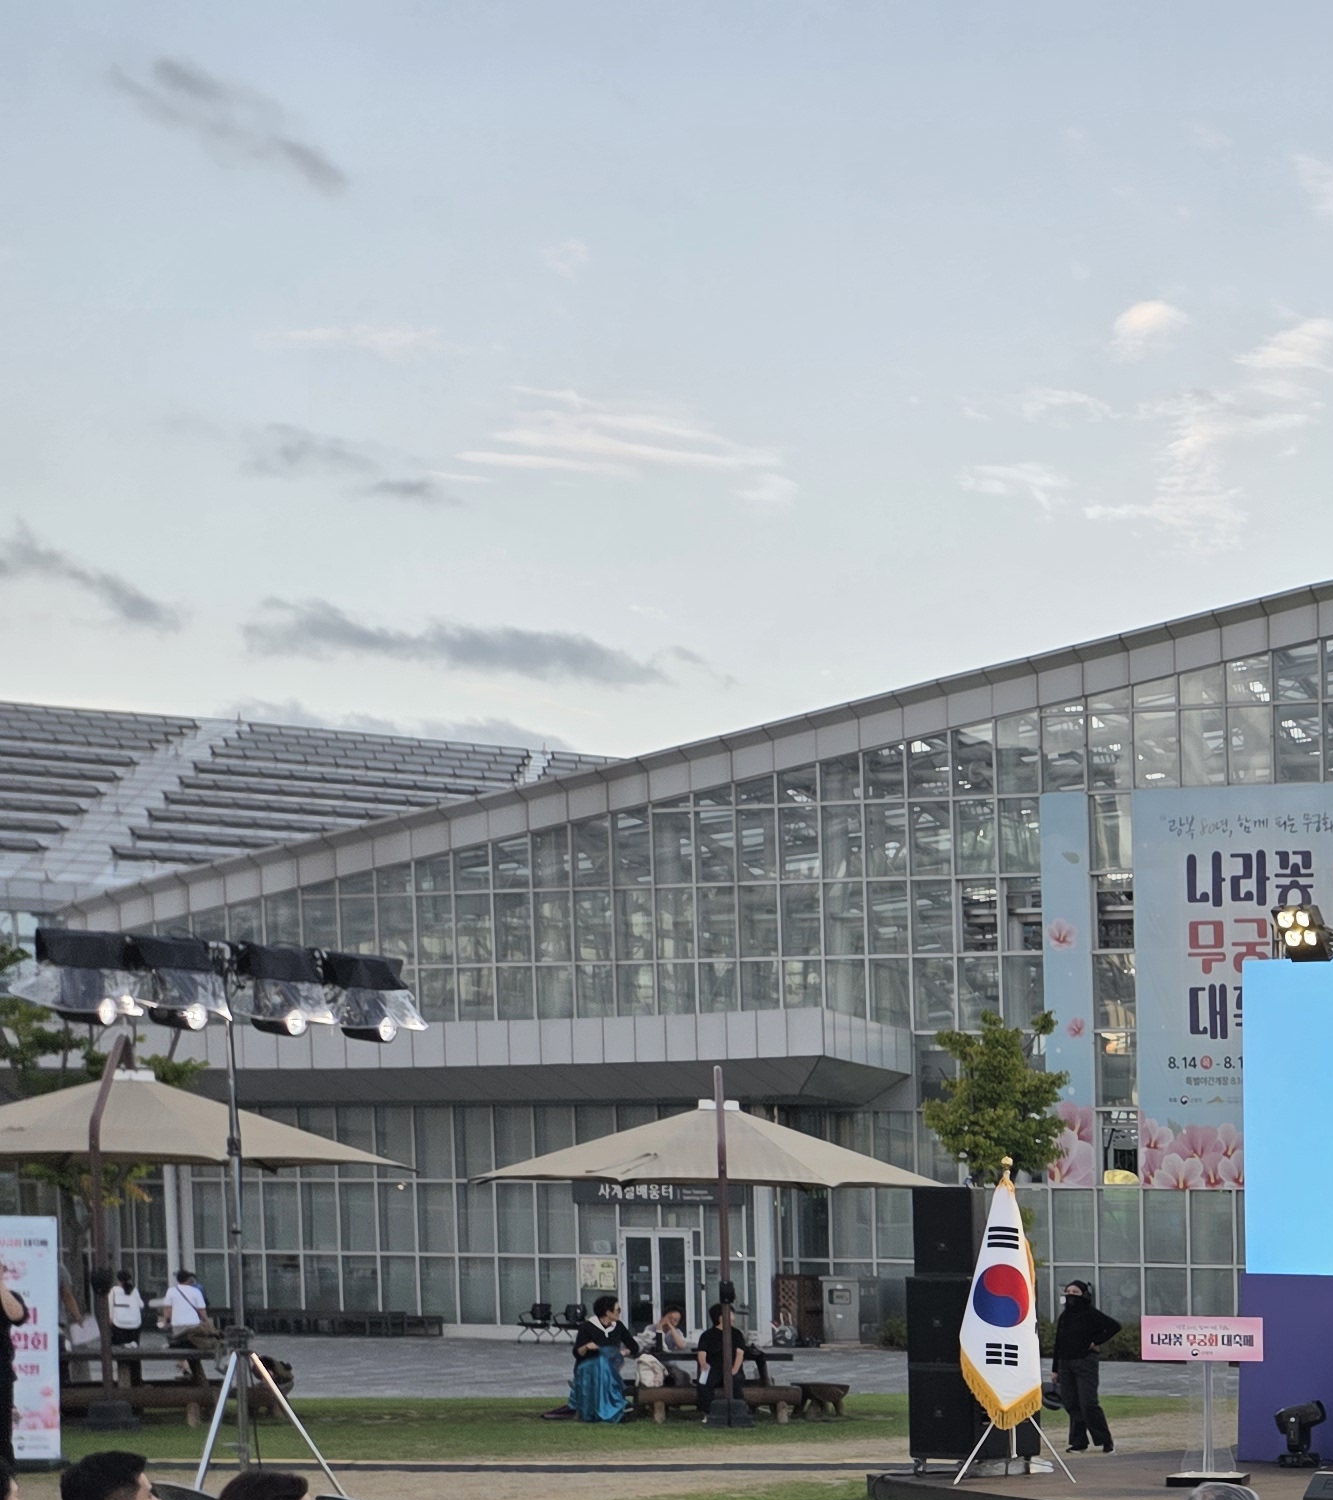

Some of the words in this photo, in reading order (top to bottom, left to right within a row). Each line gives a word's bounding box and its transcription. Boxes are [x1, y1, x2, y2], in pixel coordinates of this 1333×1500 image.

[1187, 849, 1314, 907] 나라꽃
[1188, 918, 1270, 974] 무궁
[1186, 1333, 1219, 1347] 무궁화
